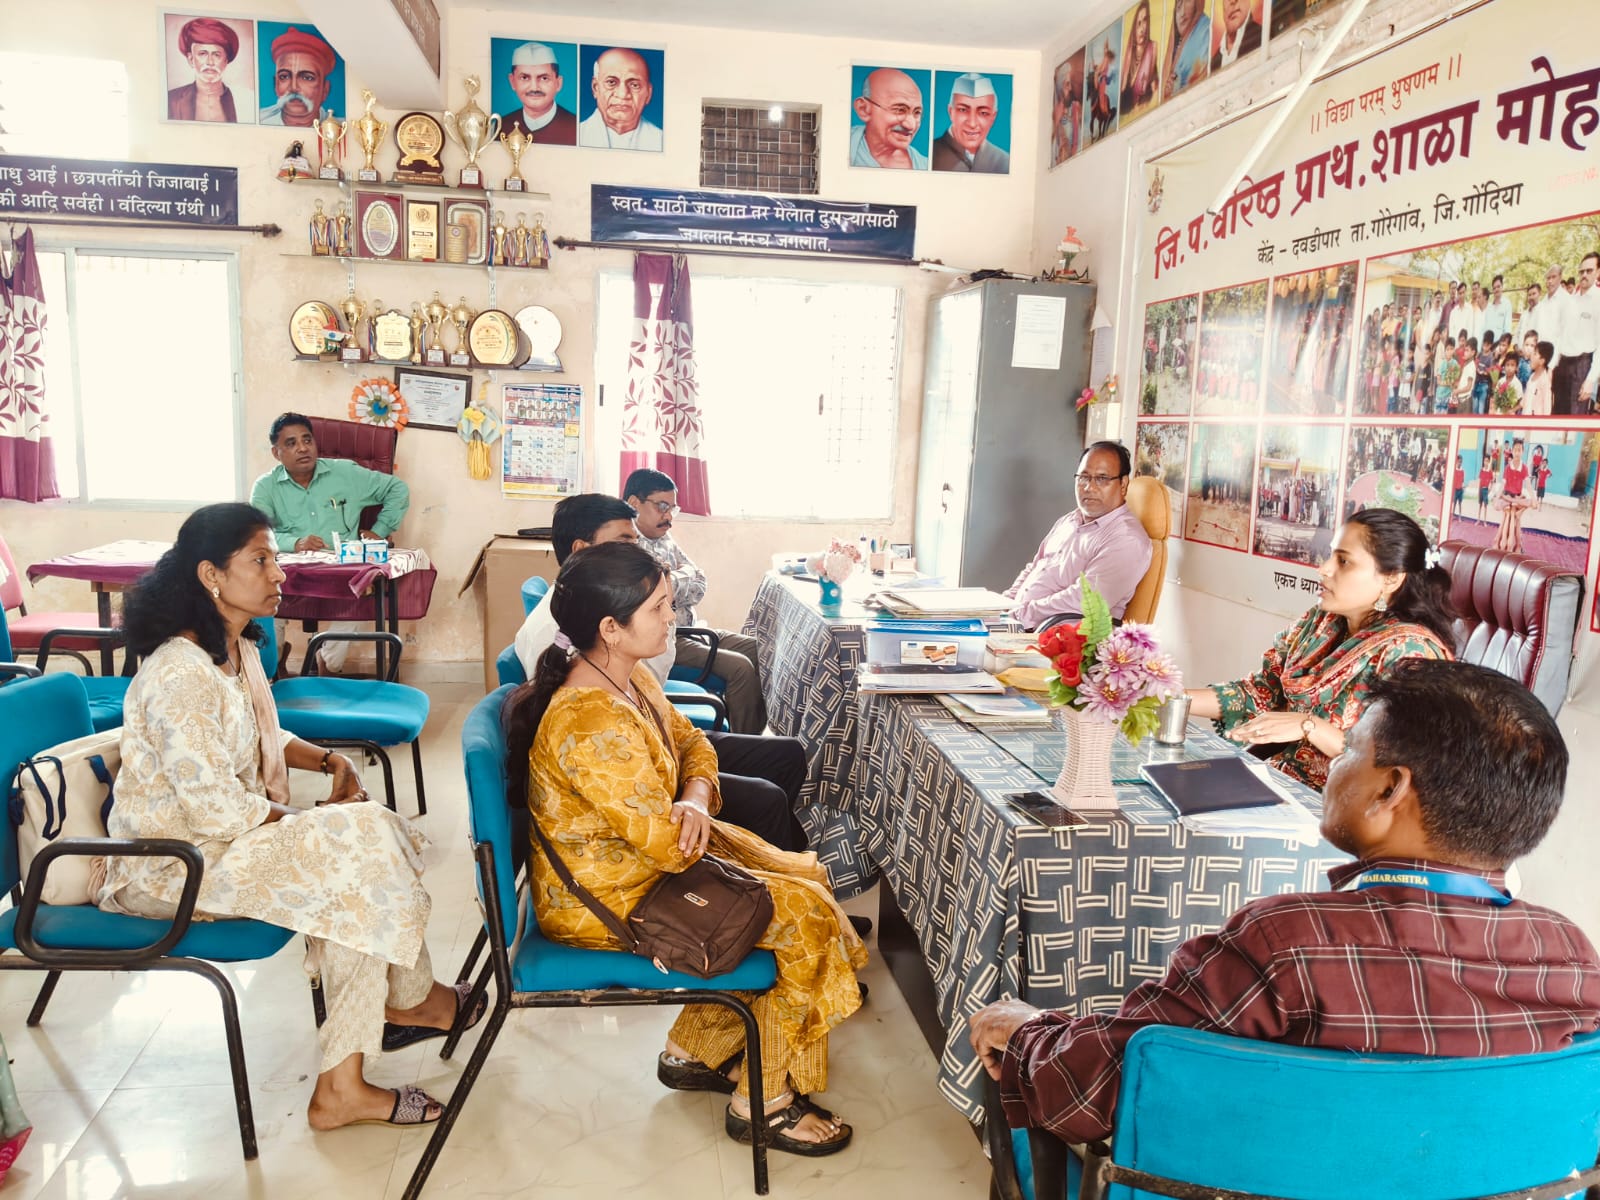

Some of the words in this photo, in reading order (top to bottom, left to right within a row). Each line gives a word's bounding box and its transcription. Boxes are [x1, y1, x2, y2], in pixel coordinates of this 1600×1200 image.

[1325, 98, 1355, 128] विद्या
[1359, 86, 1387, 115] परम्
[1391, 62, 1441, 110] भुषणम
[26, 164, 58, 188] आई
[71, 168, 143, 188] छत्रपतींची
[146, 170, 210, 195] जिजाबाई
[20, 190, 59, 211] आदि
[61, 191, 105, 213] सर्वही
[117, 194, 173, 216] वंदिल्या
[174, 197, 206, 217] ग्रंथी
[652, 195, 690, 214] साठी
[691, 200, 748, 218] जगलात
[750, 204, 770, 221] तर
[678, 227, 735, 246] जगलात
[1292, 227, 1342, 259] दवडीपार
[1274, 571, 1298, 590] एकच
[1362, 873, 1428, 886] MAHARASHTRA
